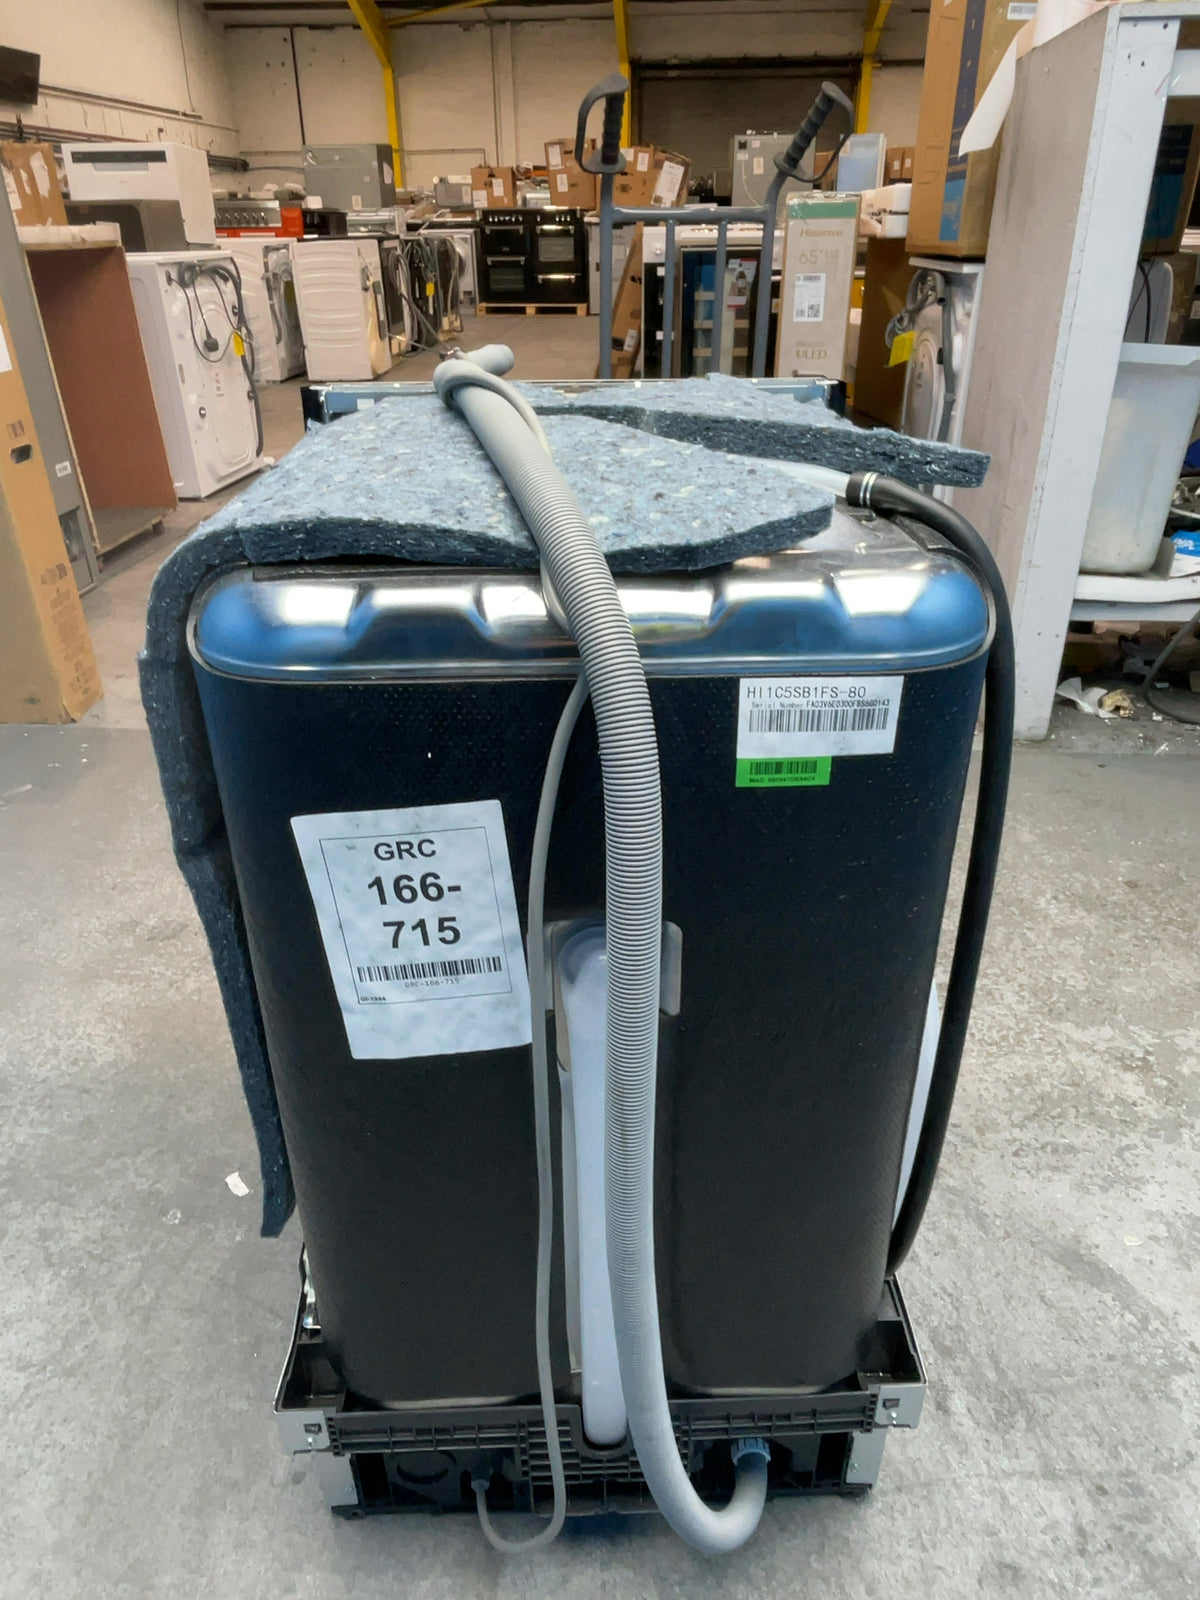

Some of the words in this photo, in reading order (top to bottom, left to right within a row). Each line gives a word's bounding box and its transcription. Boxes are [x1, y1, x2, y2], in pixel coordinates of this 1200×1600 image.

[780, 701, 803, 709] Number
[374, 839, 437, 861] GRC
[367, 872, 462, 906] 166-
[382, 916, 461, 949] 715
